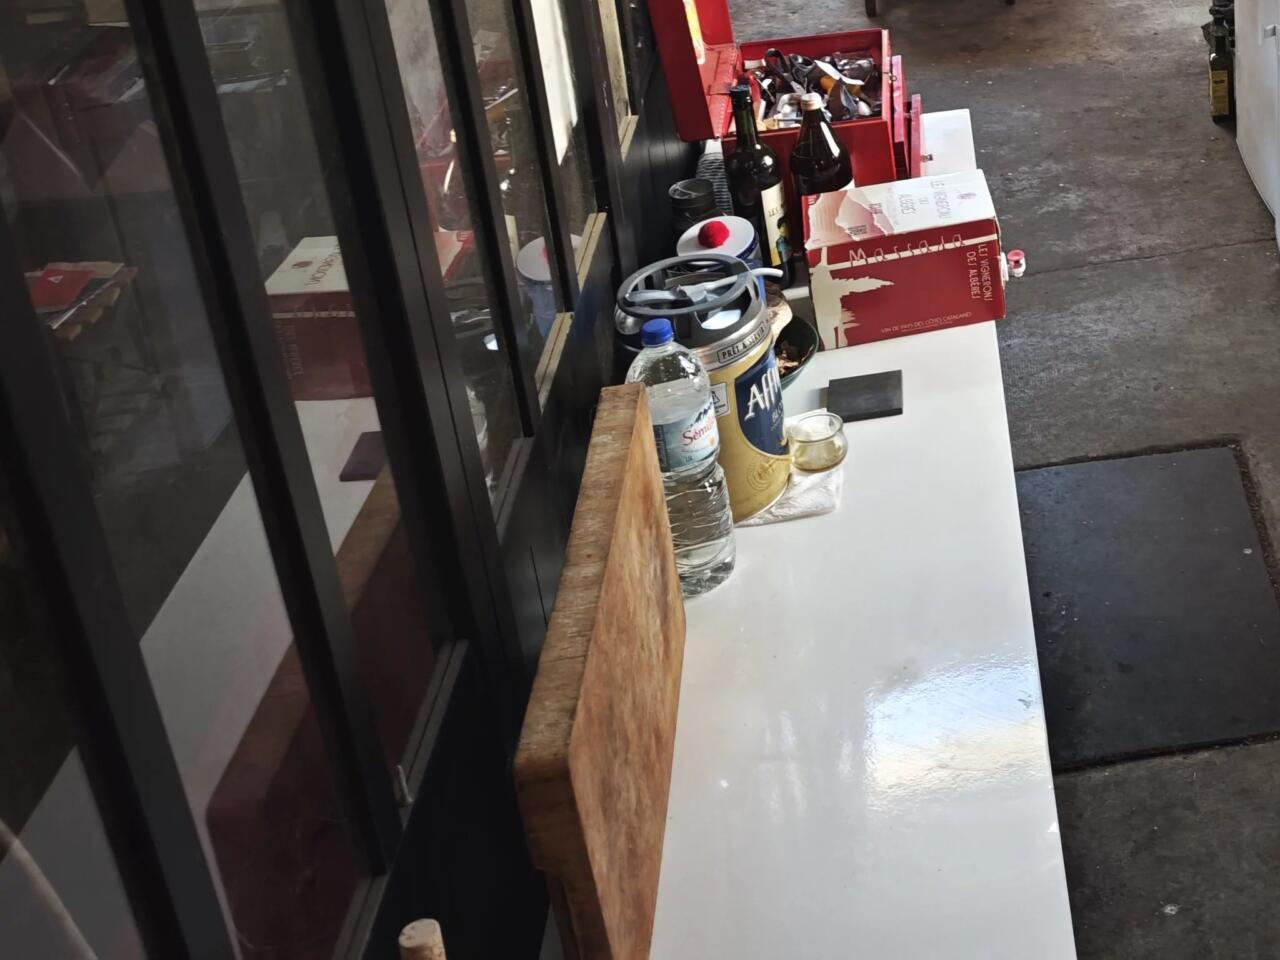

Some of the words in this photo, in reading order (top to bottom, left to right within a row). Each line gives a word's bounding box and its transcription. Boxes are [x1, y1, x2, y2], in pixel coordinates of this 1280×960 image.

[966, 250, 977, 266] DES
[977, 243, 988, 257] LES
[980, 258, 994, 302] VIGNERONS
